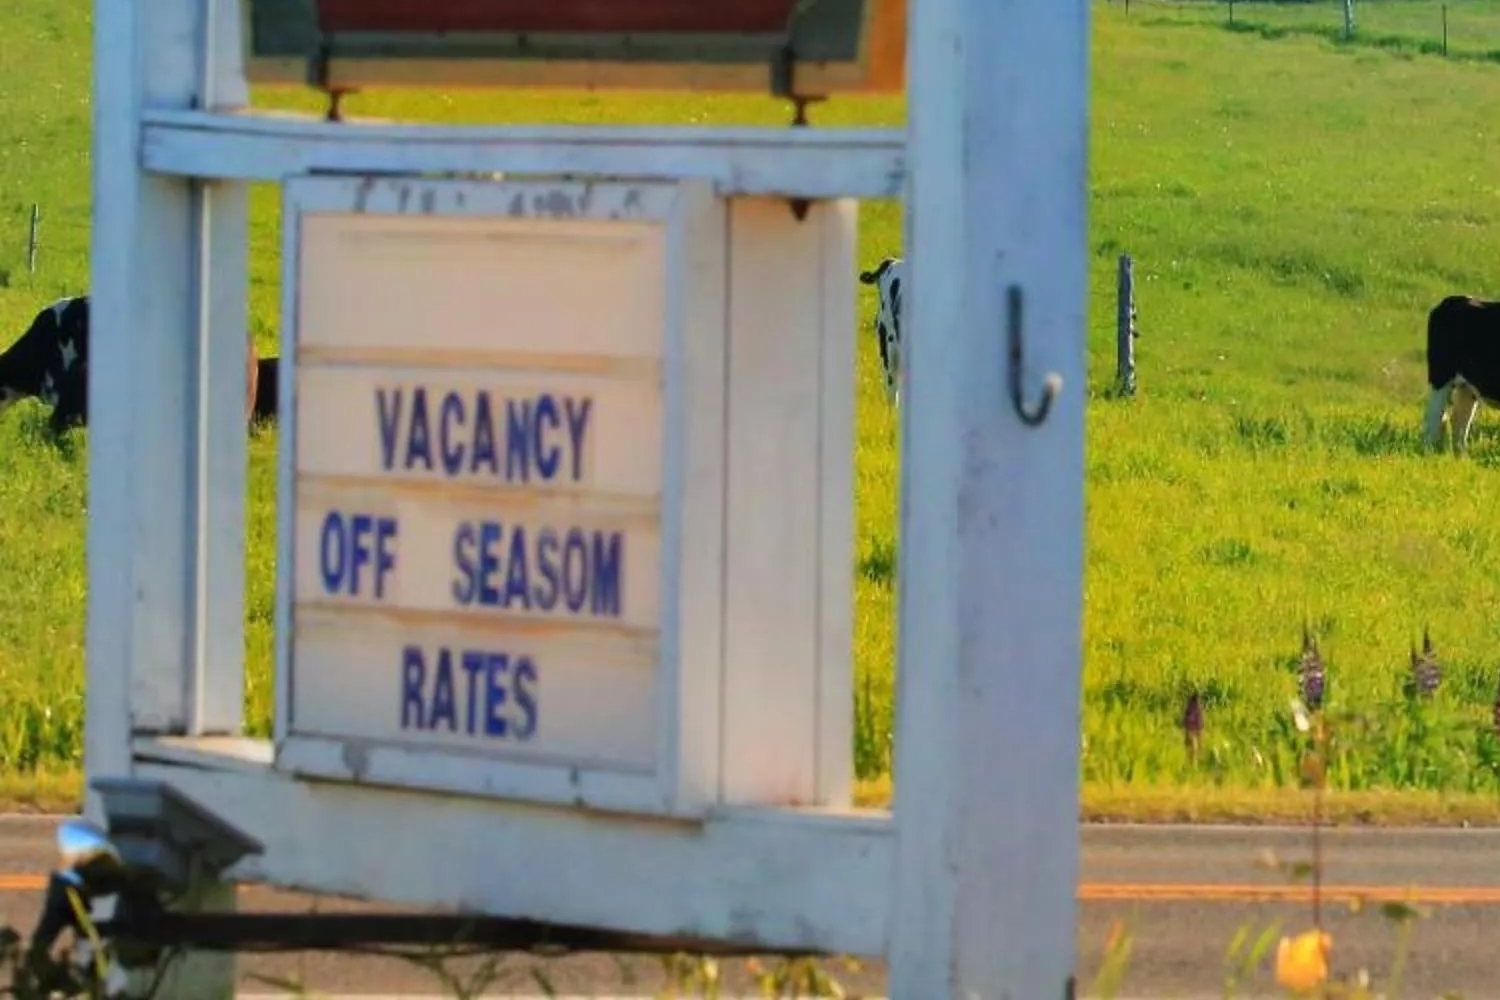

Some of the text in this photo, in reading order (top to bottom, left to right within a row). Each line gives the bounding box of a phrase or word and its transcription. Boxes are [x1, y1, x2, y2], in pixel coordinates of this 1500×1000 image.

[375, 386, 592, 482] VACANCY
[320, 511, 397, 598] OFF
[400, 646, 538, 740] RATES
